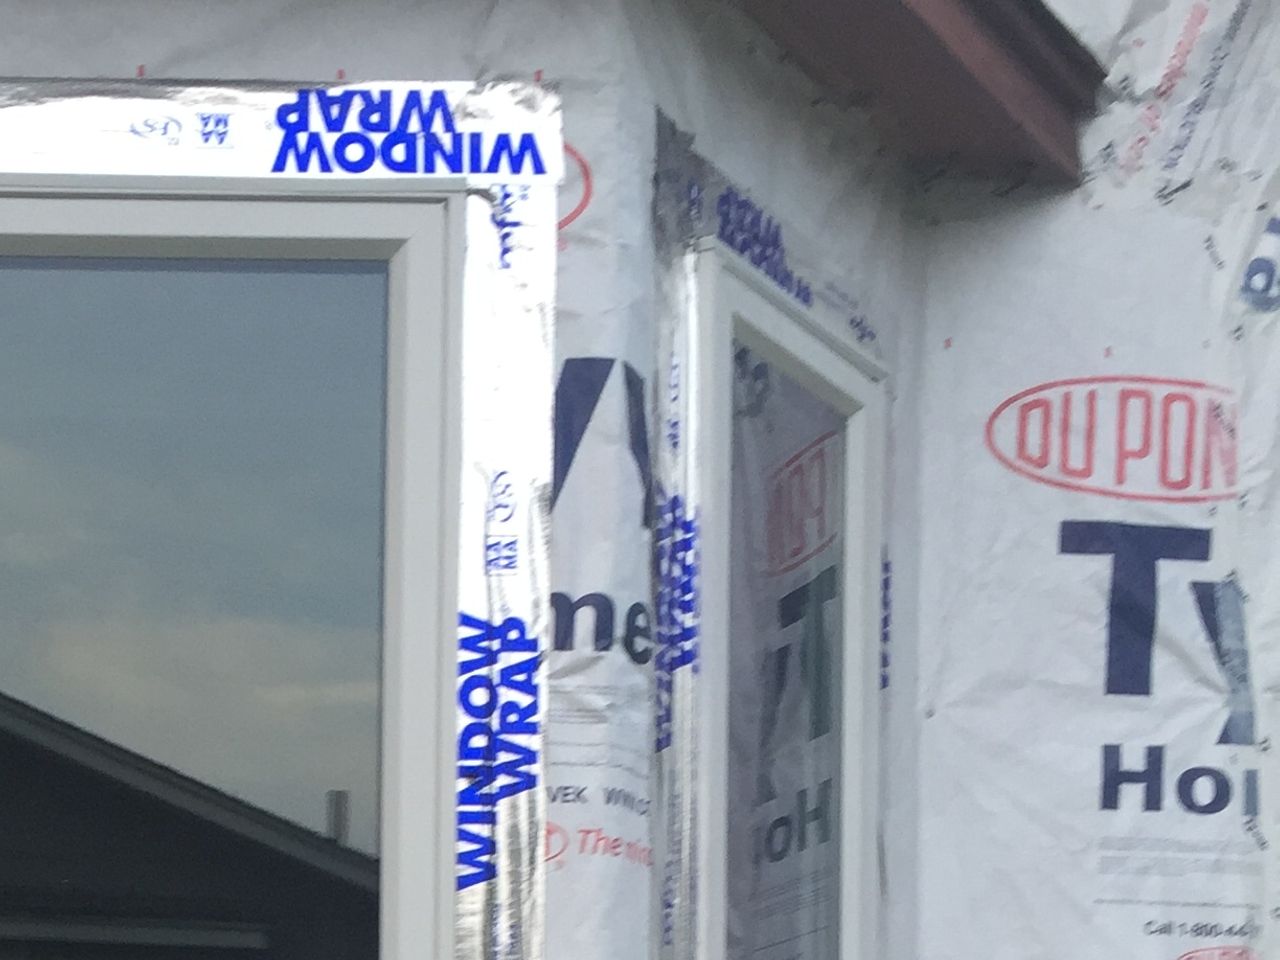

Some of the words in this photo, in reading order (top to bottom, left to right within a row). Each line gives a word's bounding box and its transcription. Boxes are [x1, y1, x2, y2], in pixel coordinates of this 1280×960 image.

[272, 131, 546, 175] WINDOW
[277, 89, 457, 133] WRAP
[456, 612, 497, 890] WINDOW
[495, 615, 539, 800] WRAP
